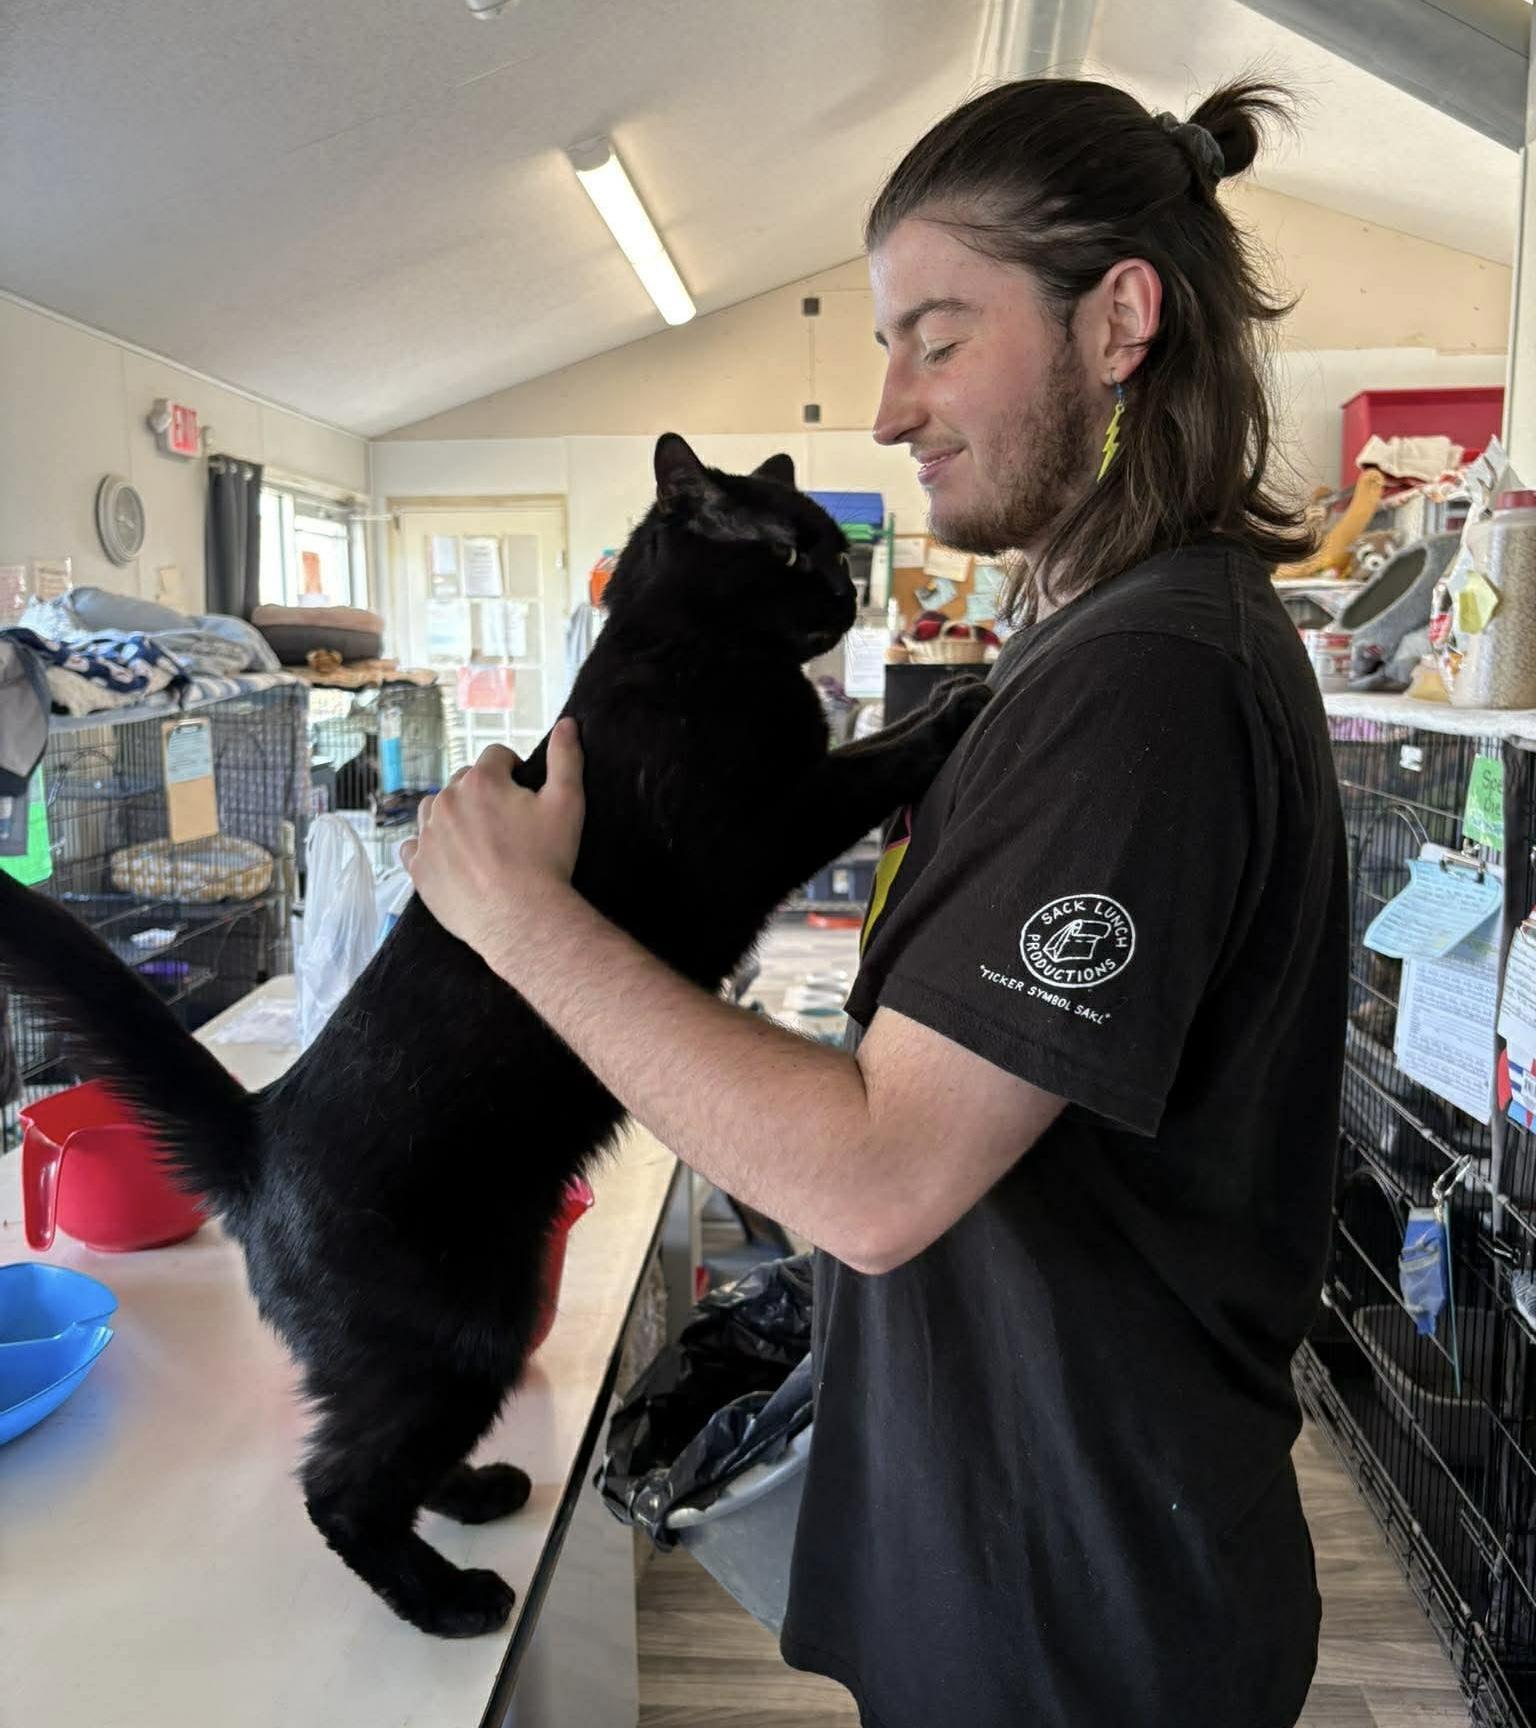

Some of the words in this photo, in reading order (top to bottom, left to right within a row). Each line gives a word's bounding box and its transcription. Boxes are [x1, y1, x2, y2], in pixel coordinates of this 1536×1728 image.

[1041, 901, 1086, 925] SACK
[1094, 902, 1128, 948] LUNCH
[1026, 934, 1116, 982] PRODUCTIONS
[1027, 986, 1071, 1011] SYMBOL
